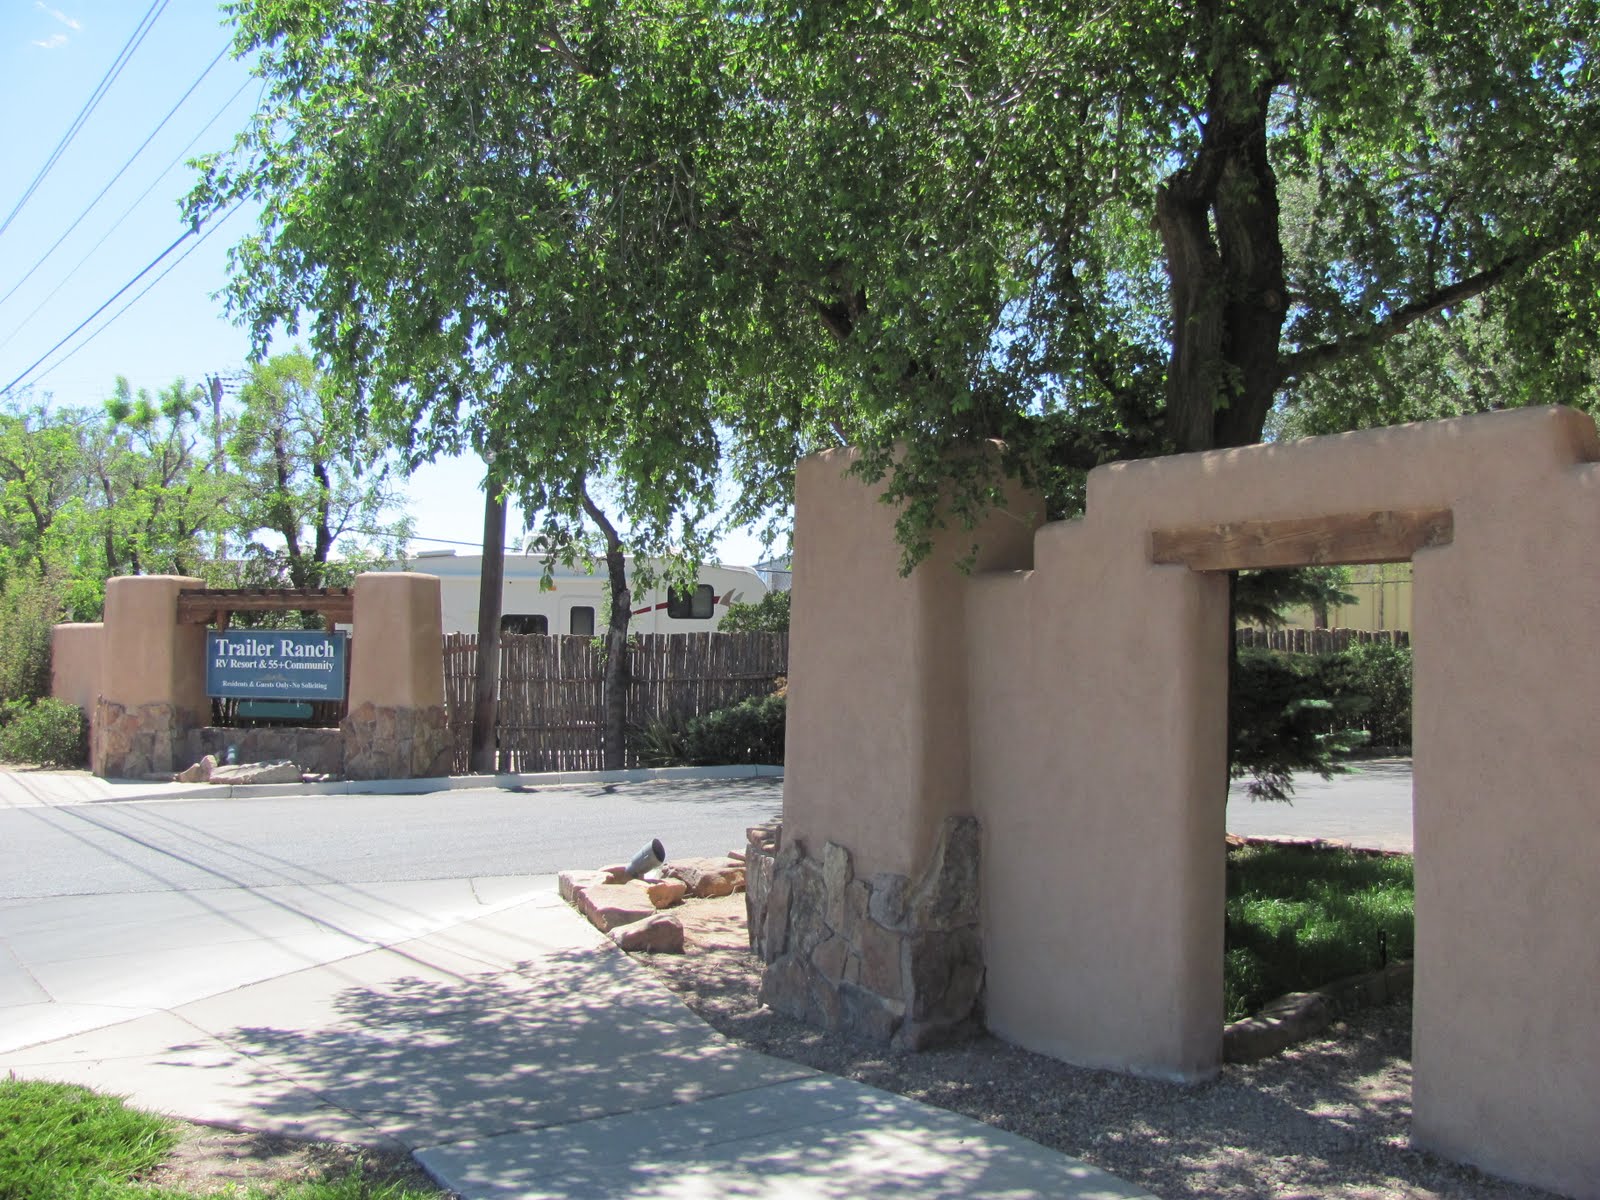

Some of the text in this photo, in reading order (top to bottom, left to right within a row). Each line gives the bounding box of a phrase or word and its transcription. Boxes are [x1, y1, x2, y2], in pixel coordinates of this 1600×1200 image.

[215, 638, 335, 658] Trailer Ranch
[215, 659, 228, 668] RV
[230, 659, 257, 669] Resort
[259, 660, 268, 669] &
[222, 680, 248, 688] Residents
[301, 682, 328, 690] Soliciting
